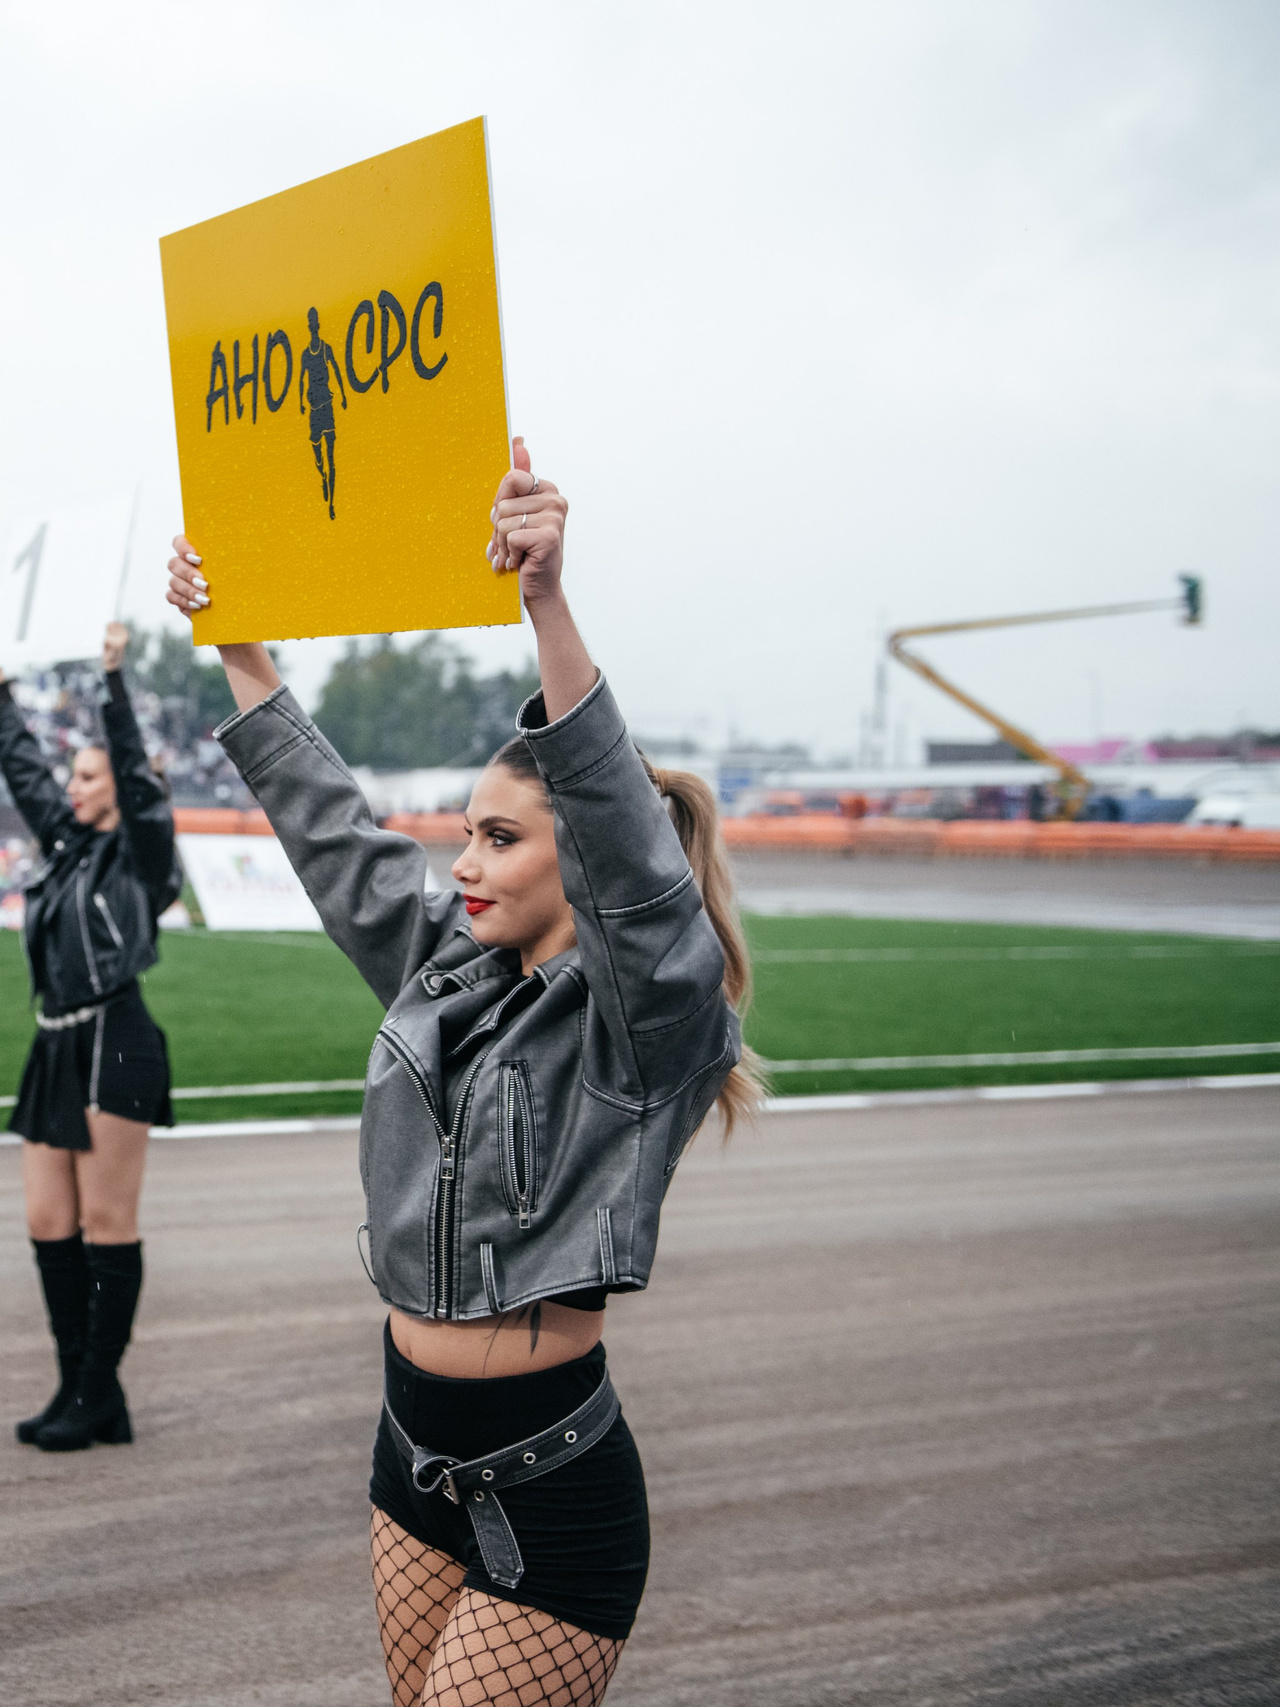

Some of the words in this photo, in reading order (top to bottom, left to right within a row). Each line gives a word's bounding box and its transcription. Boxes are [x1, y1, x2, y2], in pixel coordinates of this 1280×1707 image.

[205, 329, 293, 433] АНО
[345, 281, 448, 394] СРС
[12, 520, 48, 641] 1
